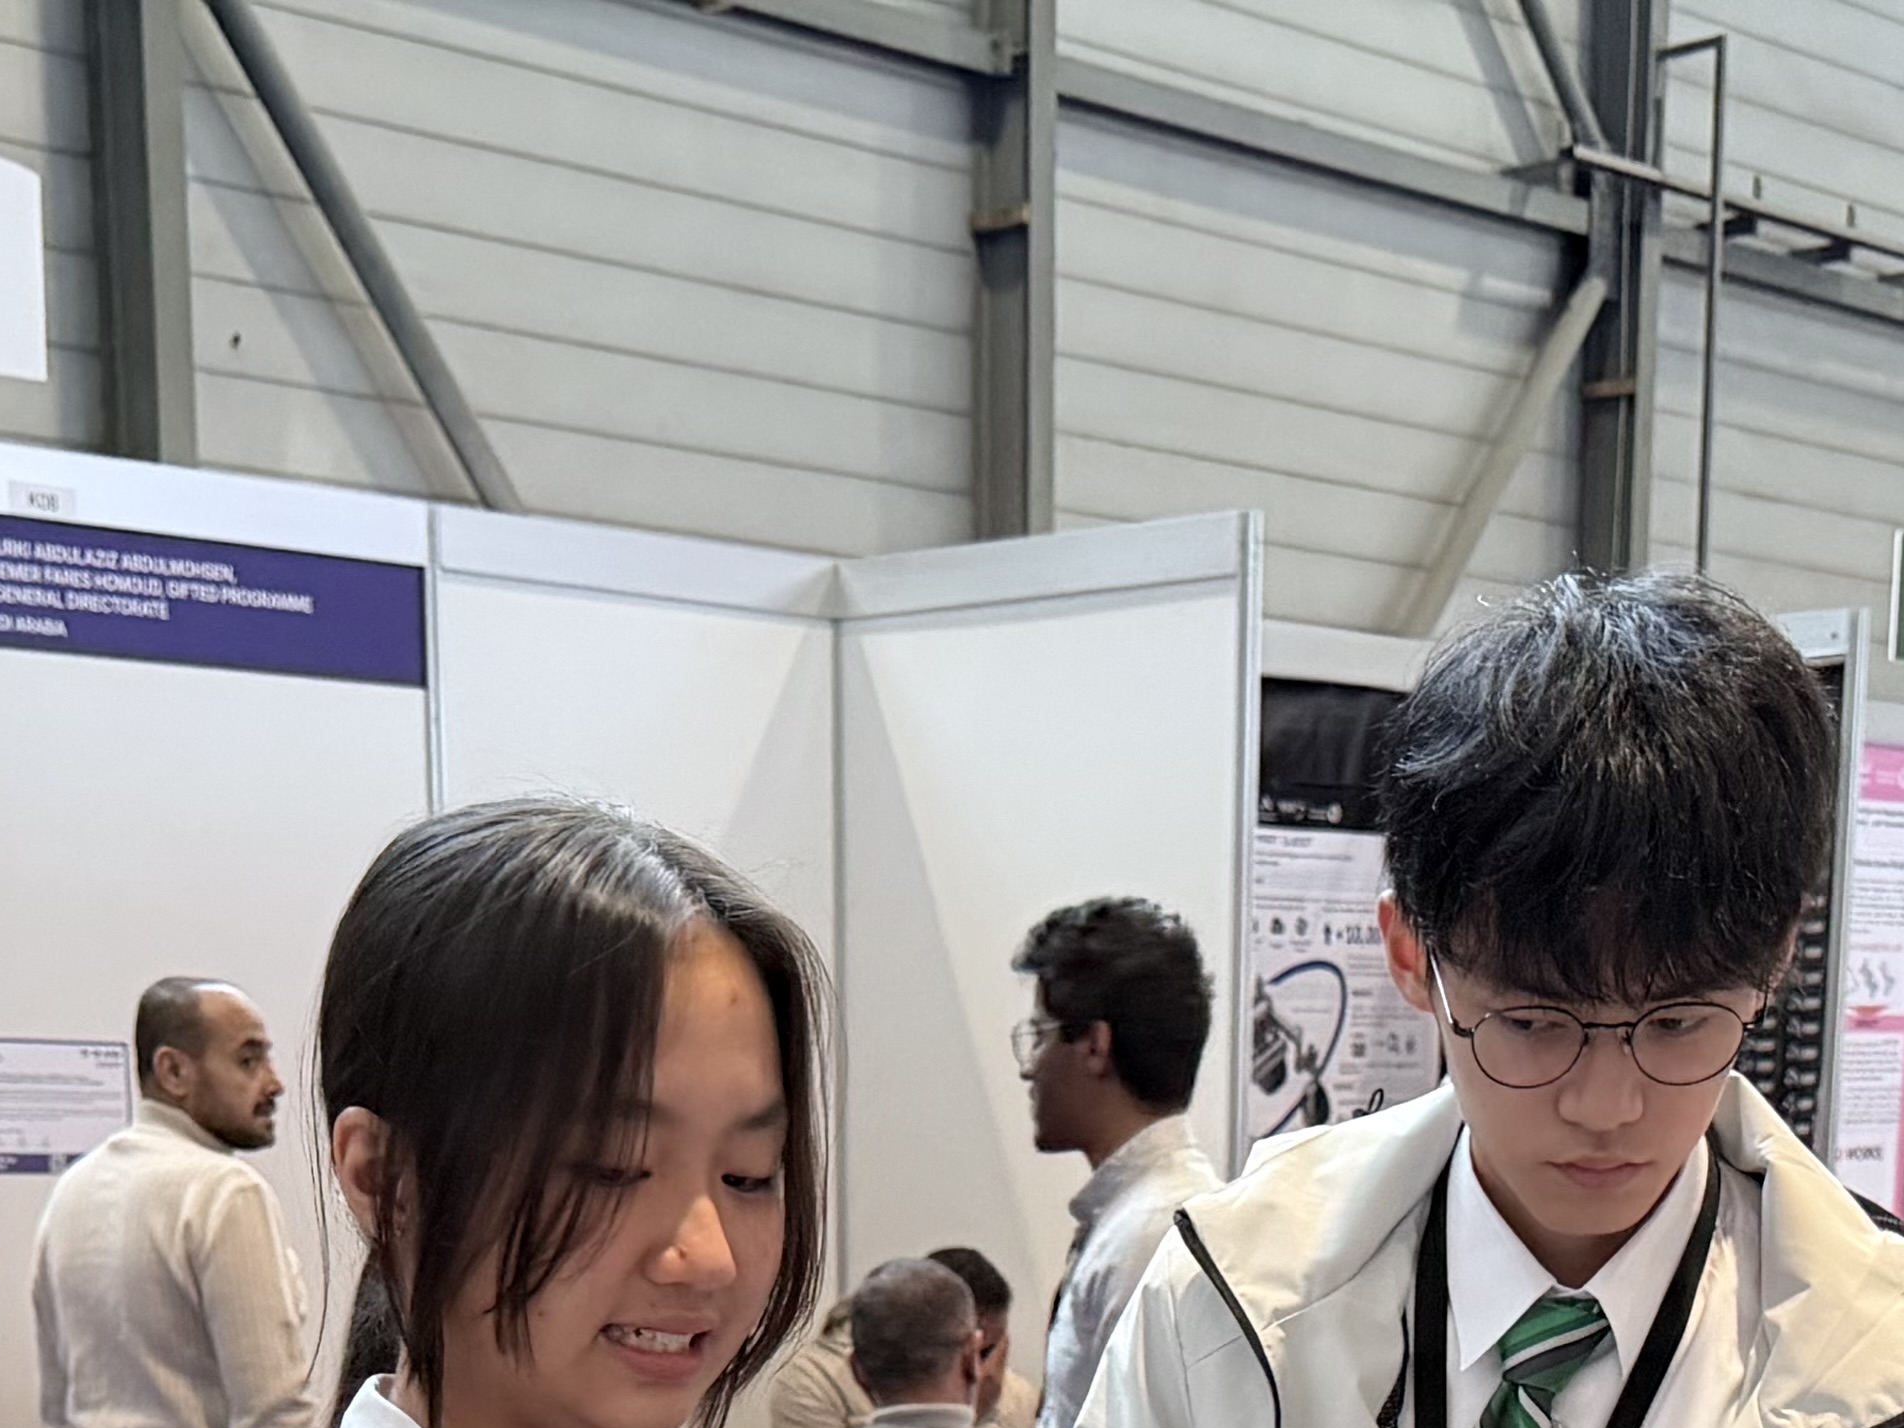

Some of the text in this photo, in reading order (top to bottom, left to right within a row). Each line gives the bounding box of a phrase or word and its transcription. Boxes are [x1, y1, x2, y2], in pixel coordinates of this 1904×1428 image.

[67, 592, 170, 620] DIRECTORATE
[220, 587, 314, 614] PROGRAMME
[16, 617, 68, 637] ARABIA
